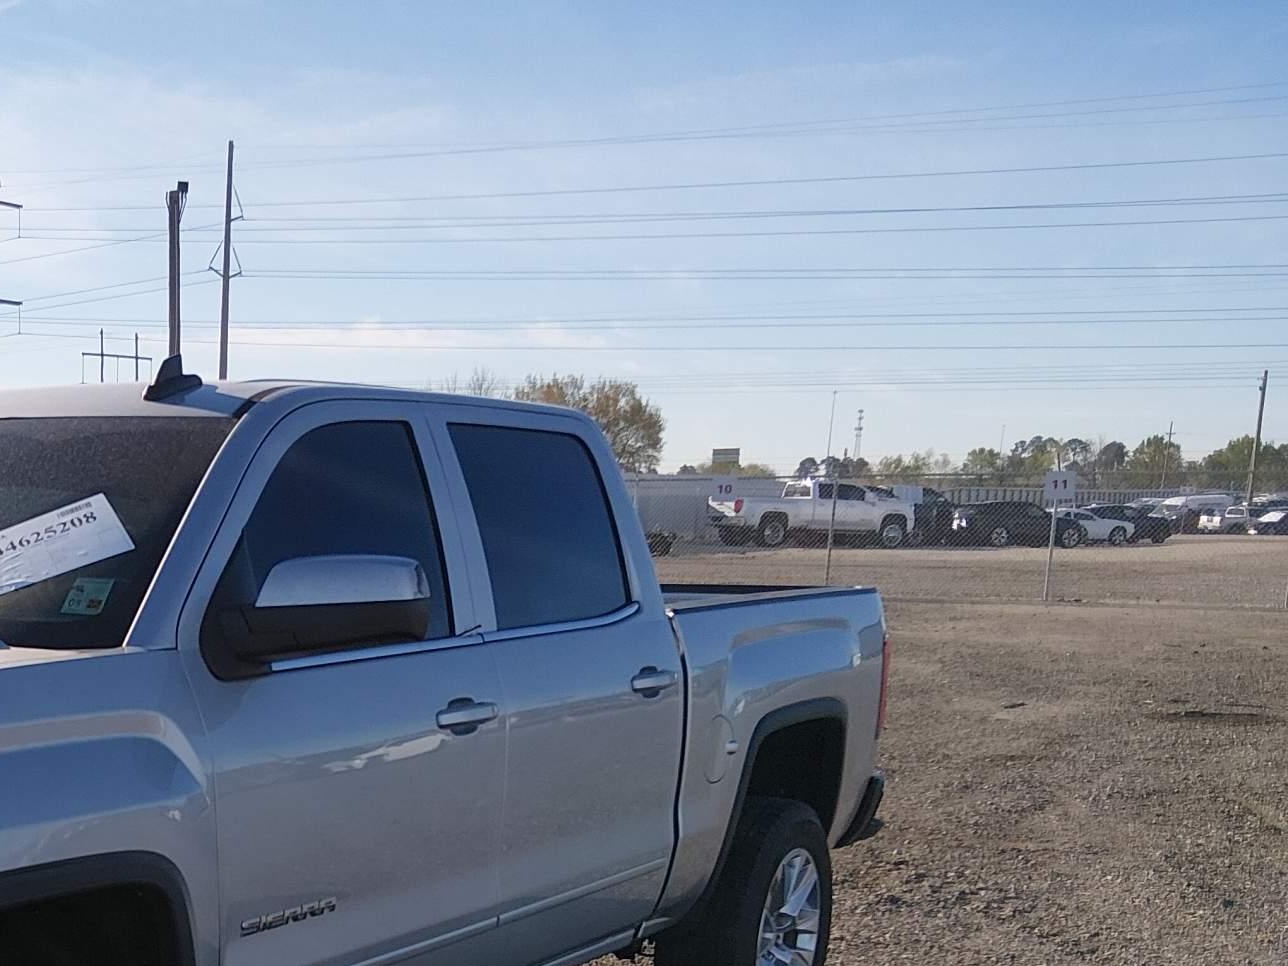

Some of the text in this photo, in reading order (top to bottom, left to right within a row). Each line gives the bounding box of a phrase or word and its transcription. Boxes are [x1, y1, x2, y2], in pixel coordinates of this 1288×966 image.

[717, 484, 733, 495] 10
[1052, 479, 1068, 490] 11
[239, 896, 337, 938] SIERRA
